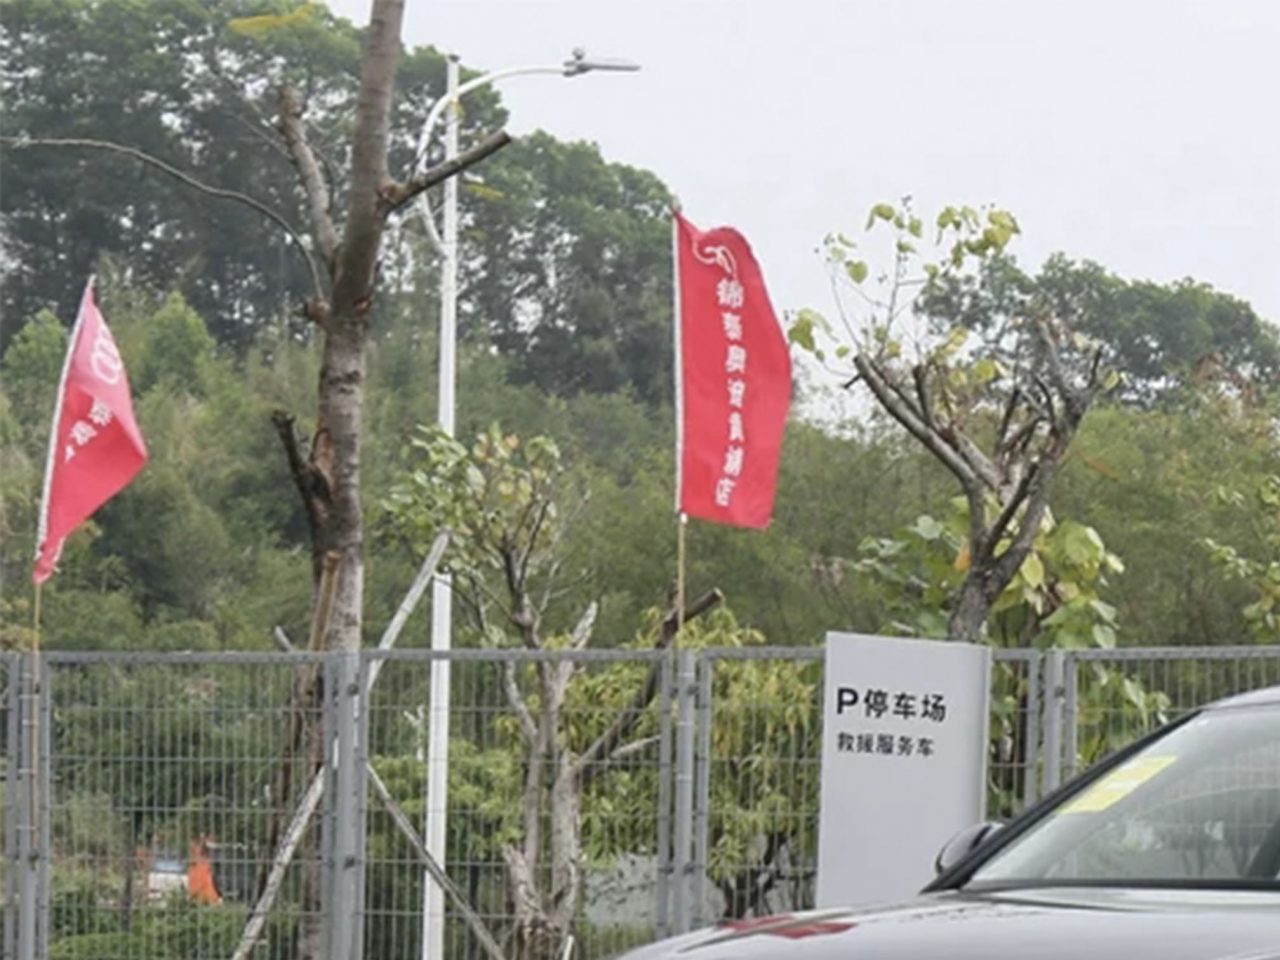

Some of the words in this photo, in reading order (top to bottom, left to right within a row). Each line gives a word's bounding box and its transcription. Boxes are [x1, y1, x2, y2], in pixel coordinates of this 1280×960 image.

[837, 731, 934, 757] 救援服务车
